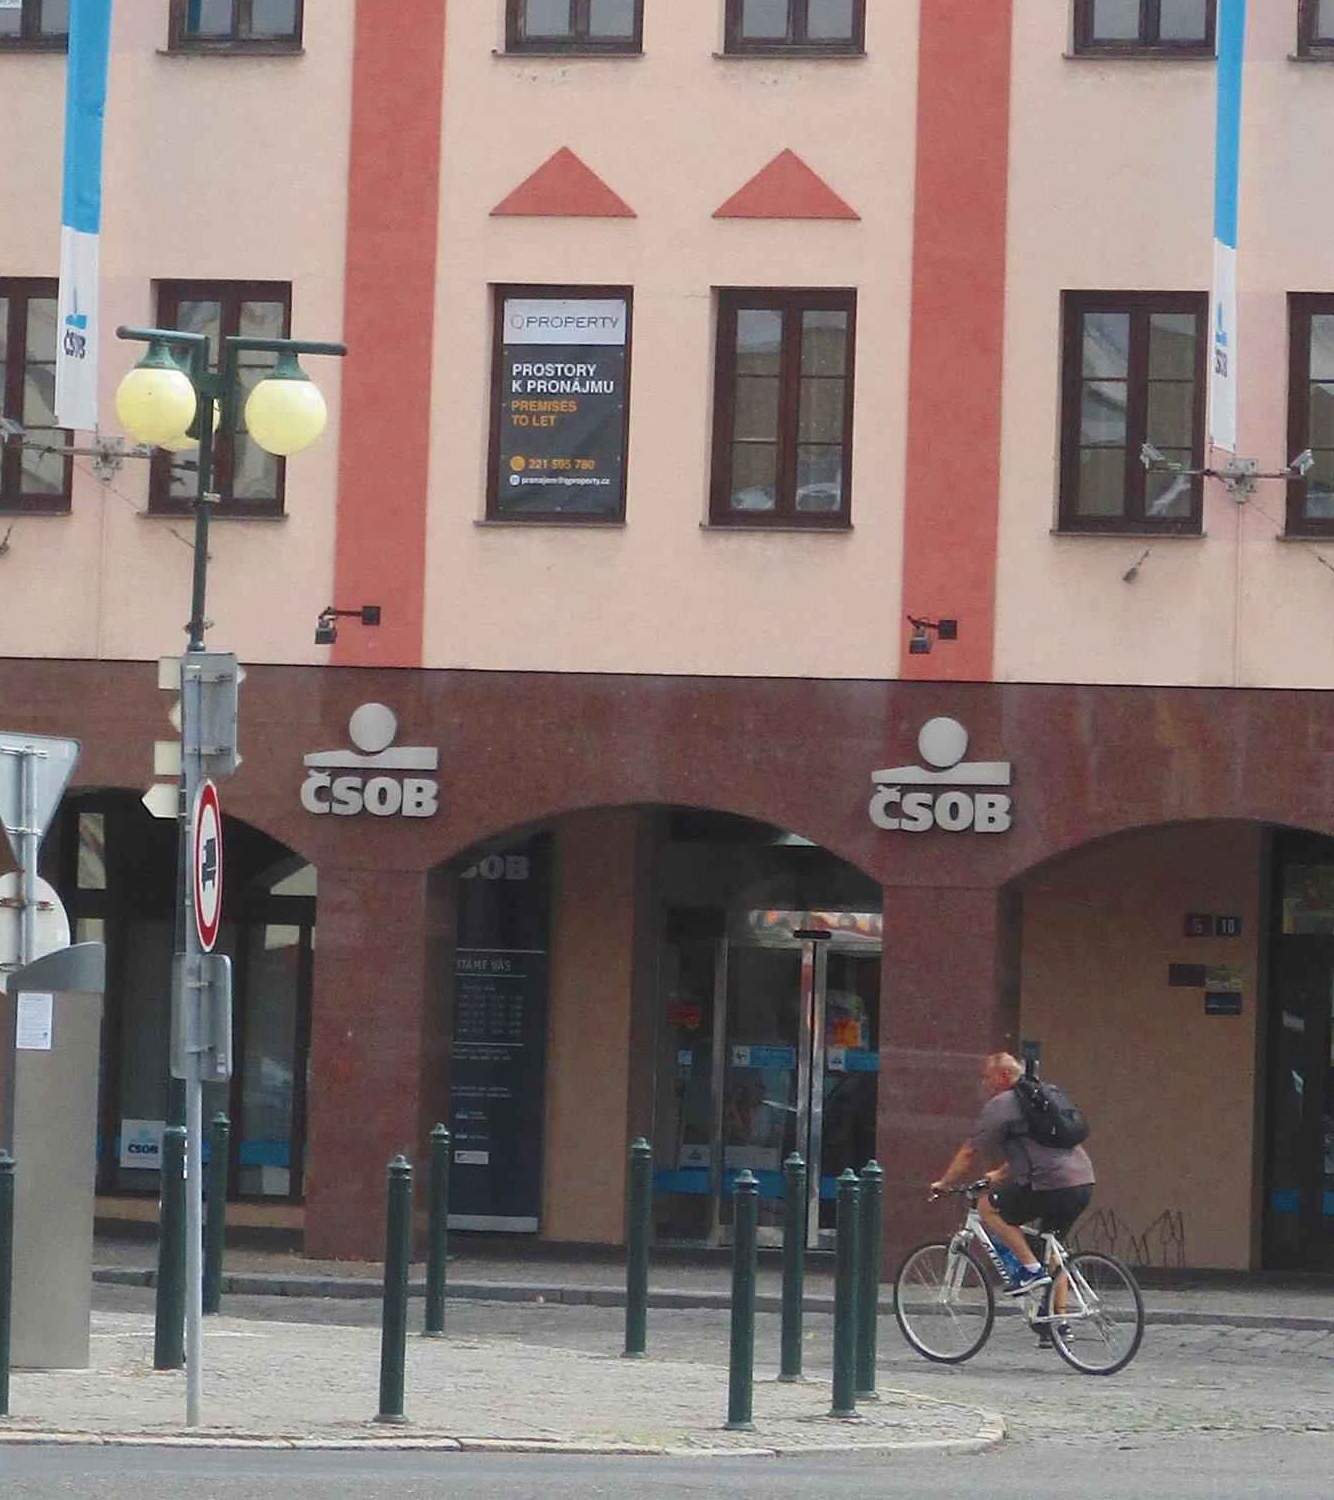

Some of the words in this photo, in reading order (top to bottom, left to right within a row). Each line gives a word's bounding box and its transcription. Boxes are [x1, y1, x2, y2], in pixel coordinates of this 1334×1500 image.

[512, 364, 597, 377] PROSTORY
[512, 380, 523, 393] K
[527, 378, 614, 394] PRONÁJMU
[511, 400, 578, 412] PREMISES
[512, 415, 529, 426] TO
[532, 415, 557, 427] LET
[300, 769, 439, 818] ČSOB
[869, 785, 1012, 833] ČSOB
